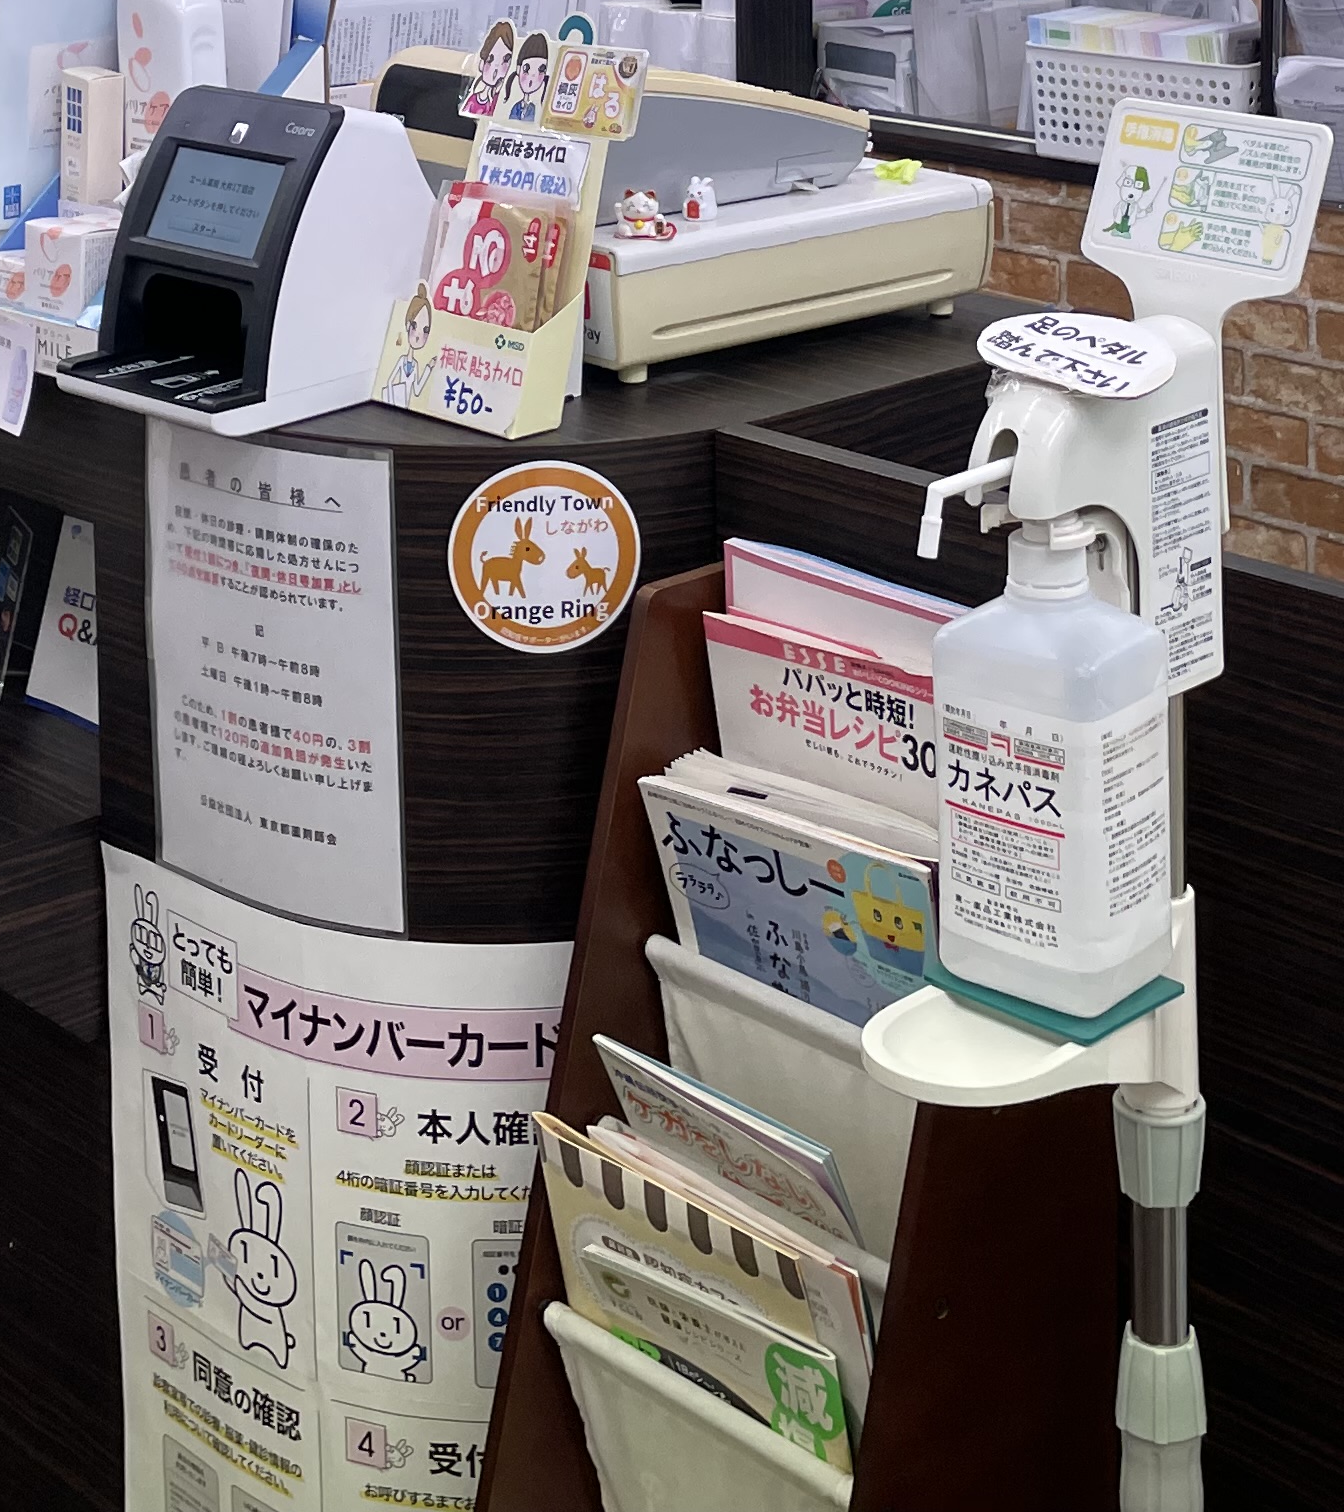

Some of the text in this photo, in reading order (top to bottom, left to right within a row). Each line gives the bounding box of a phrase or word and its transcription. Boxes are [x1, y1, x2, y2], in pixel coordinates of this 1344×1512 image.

[486, 136, 567, 163] 桐灰はるカイロ
[169, 193, 260, 219] スタートボタンを押してください
[507, 337, 525, 352] MSD
[1024, 315, 1146, 367] 足のペダル
[985, 330, 1130, 394] 踏んで下さい
[475, 495, 614, 516] Friendly Town
[545, 518, 609, 536] しながわ
[474, 599, 609, 625] Orange Ring
[57, 612, 97, 646] Q&
[254, 624, 265, 638] 記
[782, 642, 846, 674] ESSE
[782, 666, 915, 730] パパッと時短!
[948, 758, 1061, 818] カネパス
[662, 811, 846, 899] ふなっしー
[172, 922, 233, 975] とっても
[181, 958, 223, 1003] 簡単!
[243, 982, 561, 1071] マイナンバーカード
[197, 1043, 265, 1104] 受付
[199, 1087, 297, 1145] マイナンバーカードを
[348, 1098, 366, 1127] 2
[208, 1111, 287, 1161] カードリーダーに
[404, 1158, 498, 1180] 顔認証または
[360, 1206, 402, 1228] 顔認証
[441, 1314, 465, 1331] or
[155, 1325, 167, 1353] 3
[193, 1350, 302, 1442] 同意の確認
[357, 1431, 375, 1458] 4
